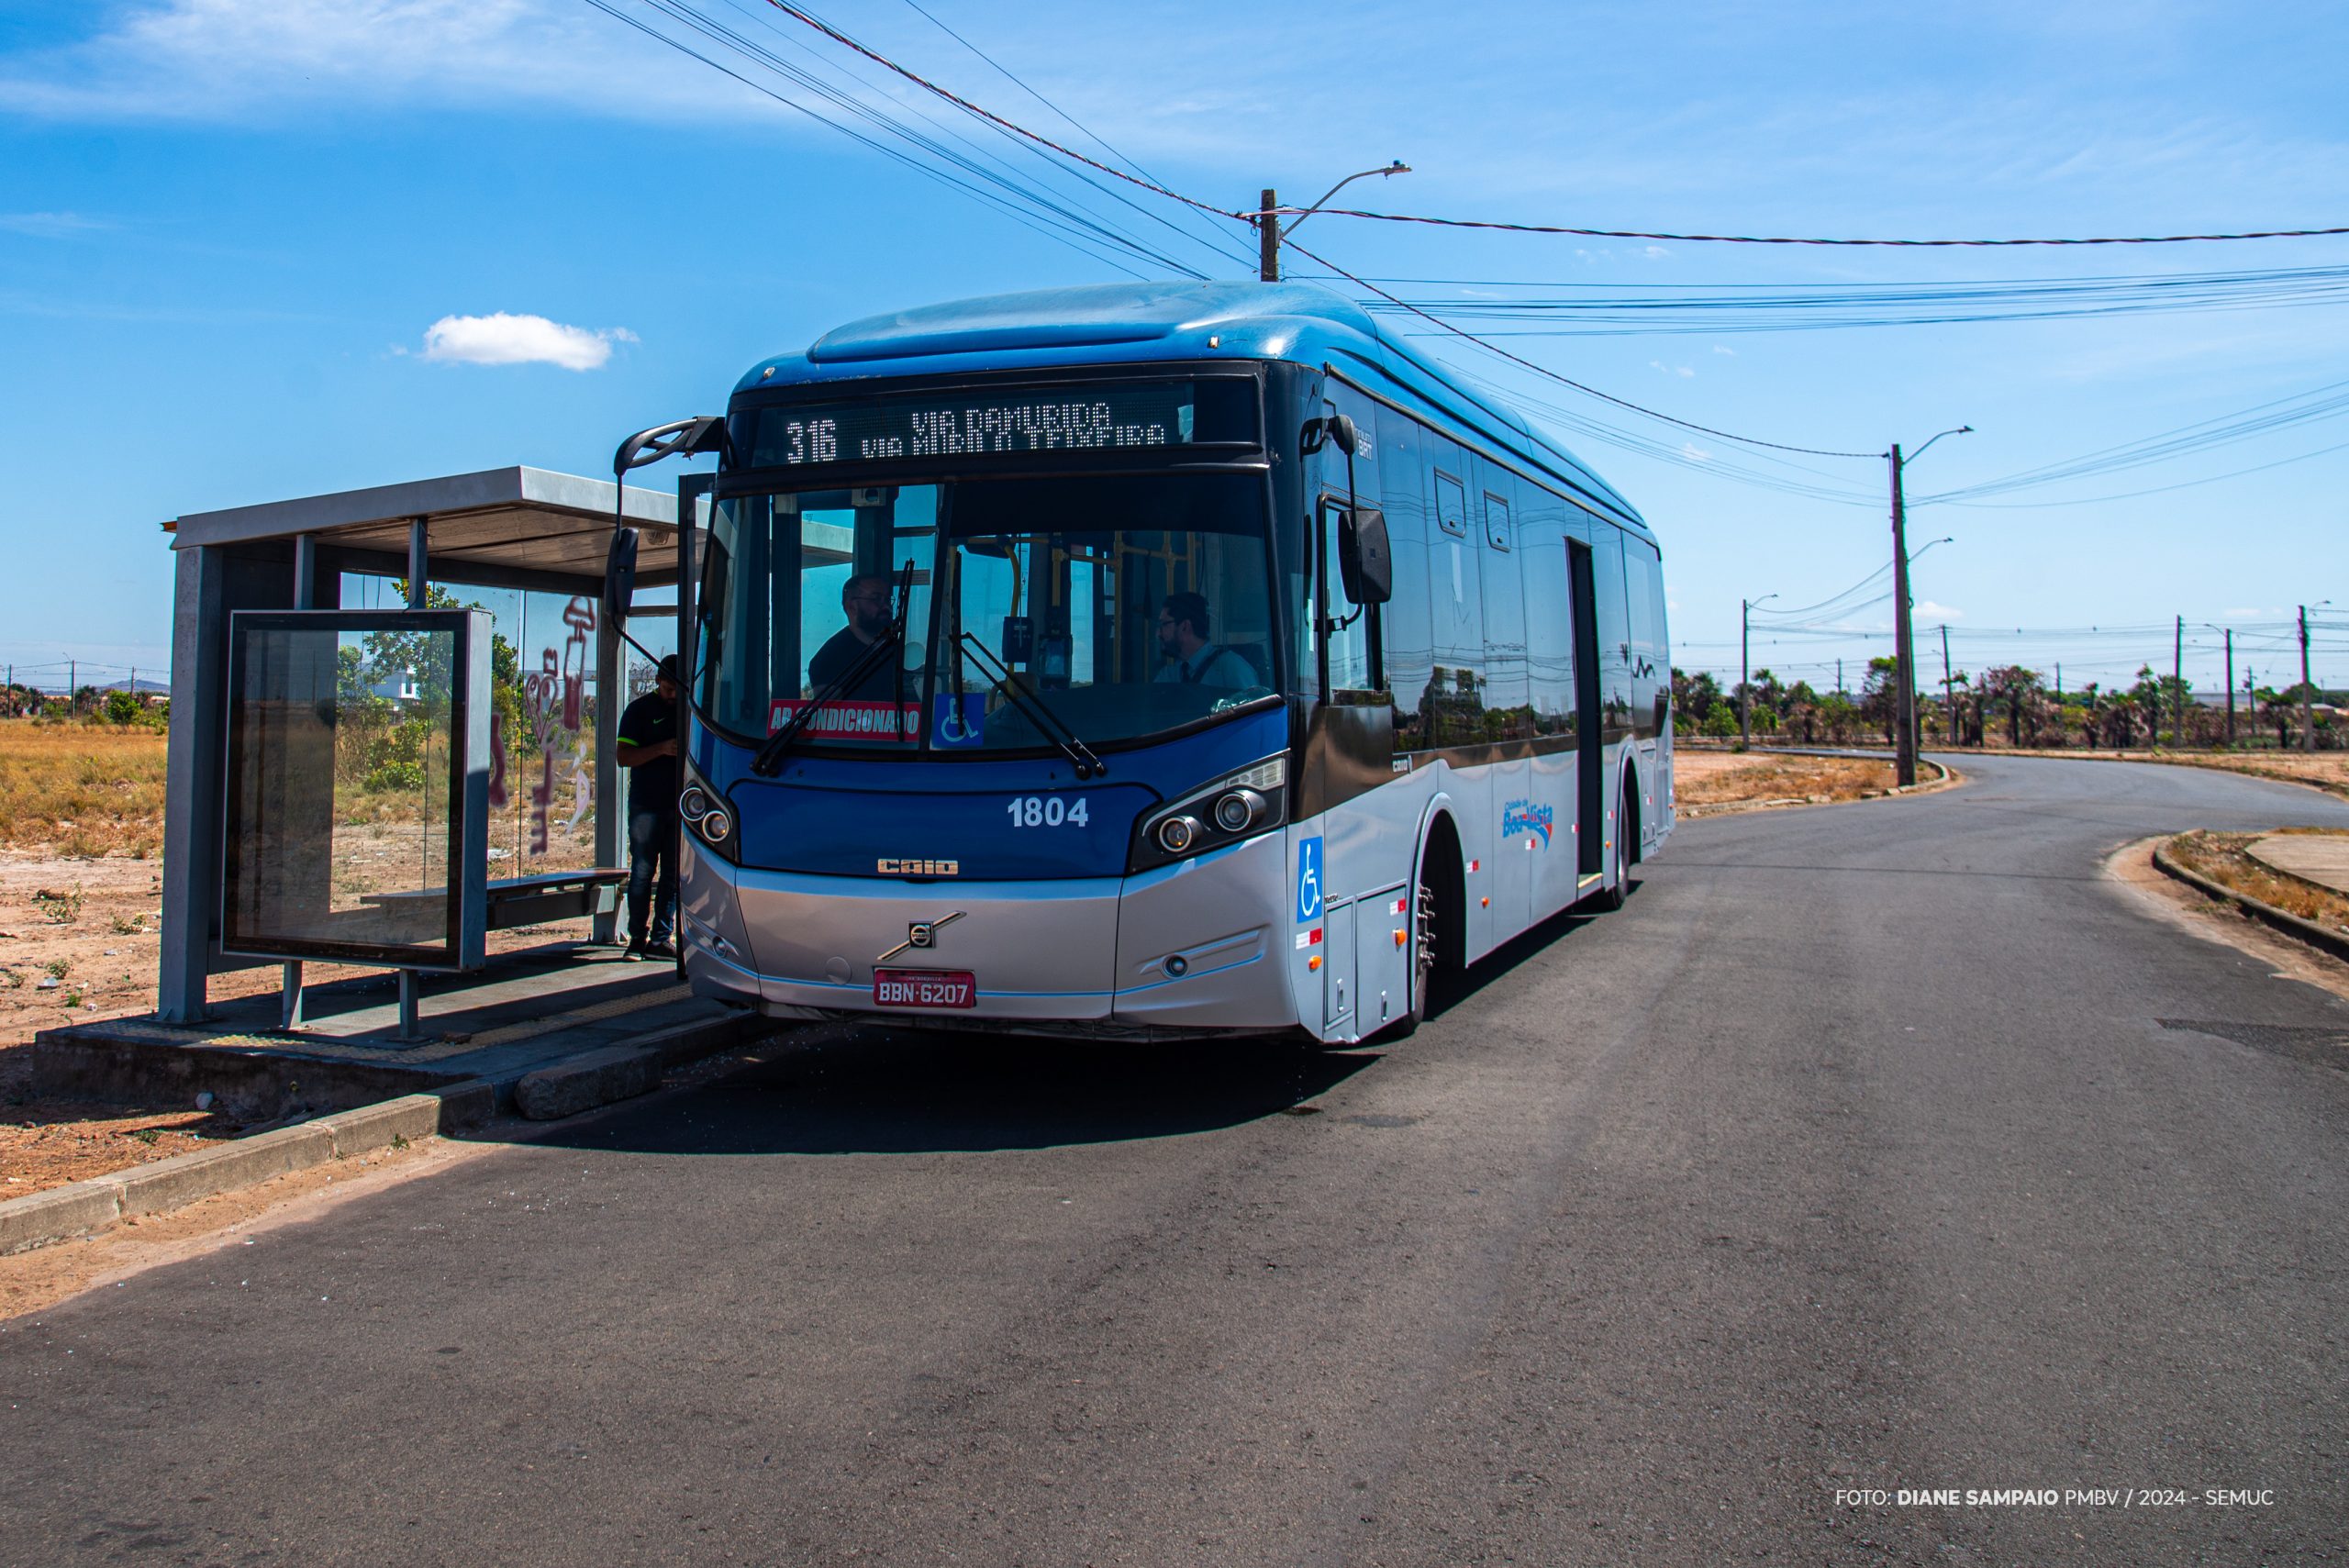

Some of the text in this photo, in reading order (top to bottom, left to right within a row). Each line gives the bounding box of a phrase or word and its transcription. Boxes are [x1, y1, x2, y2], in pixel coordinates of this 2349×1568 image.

[787, 418, 837, 464] 316
[1008, 796, 1089, 828] 1804
[877, 858, 959, 875] CAIO
